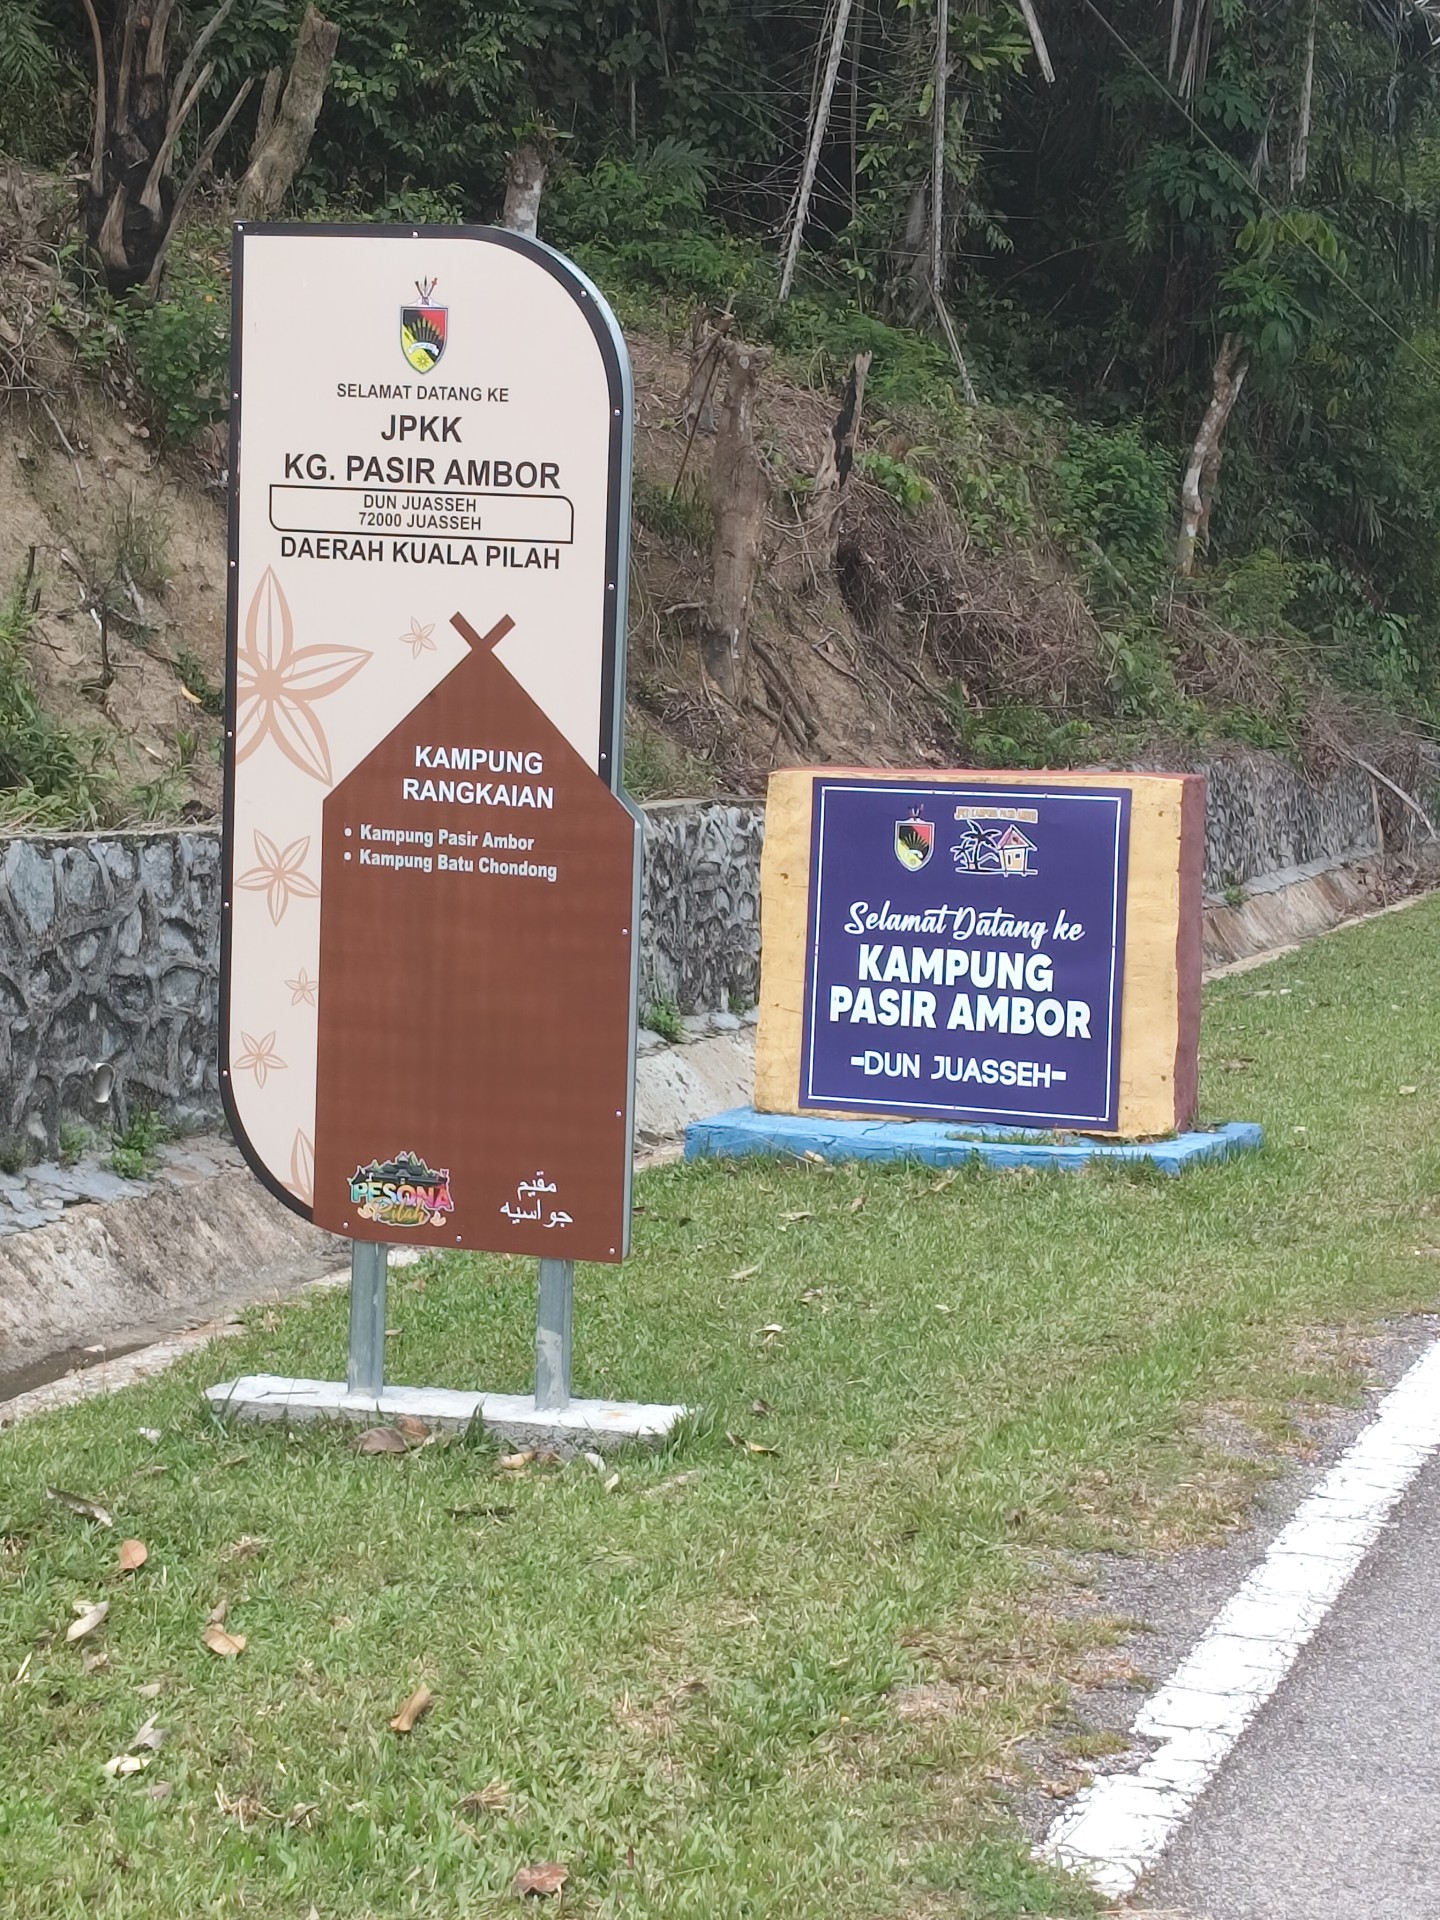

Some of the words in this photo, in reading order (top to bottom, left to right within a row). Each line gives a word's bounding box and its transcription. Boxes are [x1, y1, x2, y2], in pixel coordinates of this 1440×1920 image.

[337, 383, 412, 400] SELAMAT
[416, 385, 482, 401] DATANG
[487, 387, 509, 402] KE
[380, 415, 463, 443] JPKK
[284, 453, 335, 480] KG.
[346, 455, 435, 484] PASIR
[444, 459, 560, 489] AMBOR
[364, 494, 397, 509] DUN
[402, 496, 476, 512] JUASSEH
[359, 512, 401, 527] 72000
[406, 514, 482, 530] JUASSEH
[281, 537, 383, 561] DAERAH
[393, 541, 478, 566] KUALA
[486, 545, 560, 569] PILAH
[415, 745, 543, 775] KAMPUNG
[403, 778, 554, 809] RANGKAIAN
[360, 824, 433, 848] Kampung
[438, 829, 478, 847] Pasir
[482, 832, 534, 851] Ambor
[359, 849, 432, 873] Kampung
[437, 854, 473, 872] Batu
[479, 857, 557, 882] Chondong
[844, 900, 957, 935] Selamat
[952, 907, 1048, 949] Datang
[1052, 909, 1085, 941] ke
[858, 944, 1054, 992] KAMPUNG
[829, 985, 937, 1029] PASIR
[946, 993, 1092, 1039] AMBOR
[351, 1181, 452, 1209] PESONA
